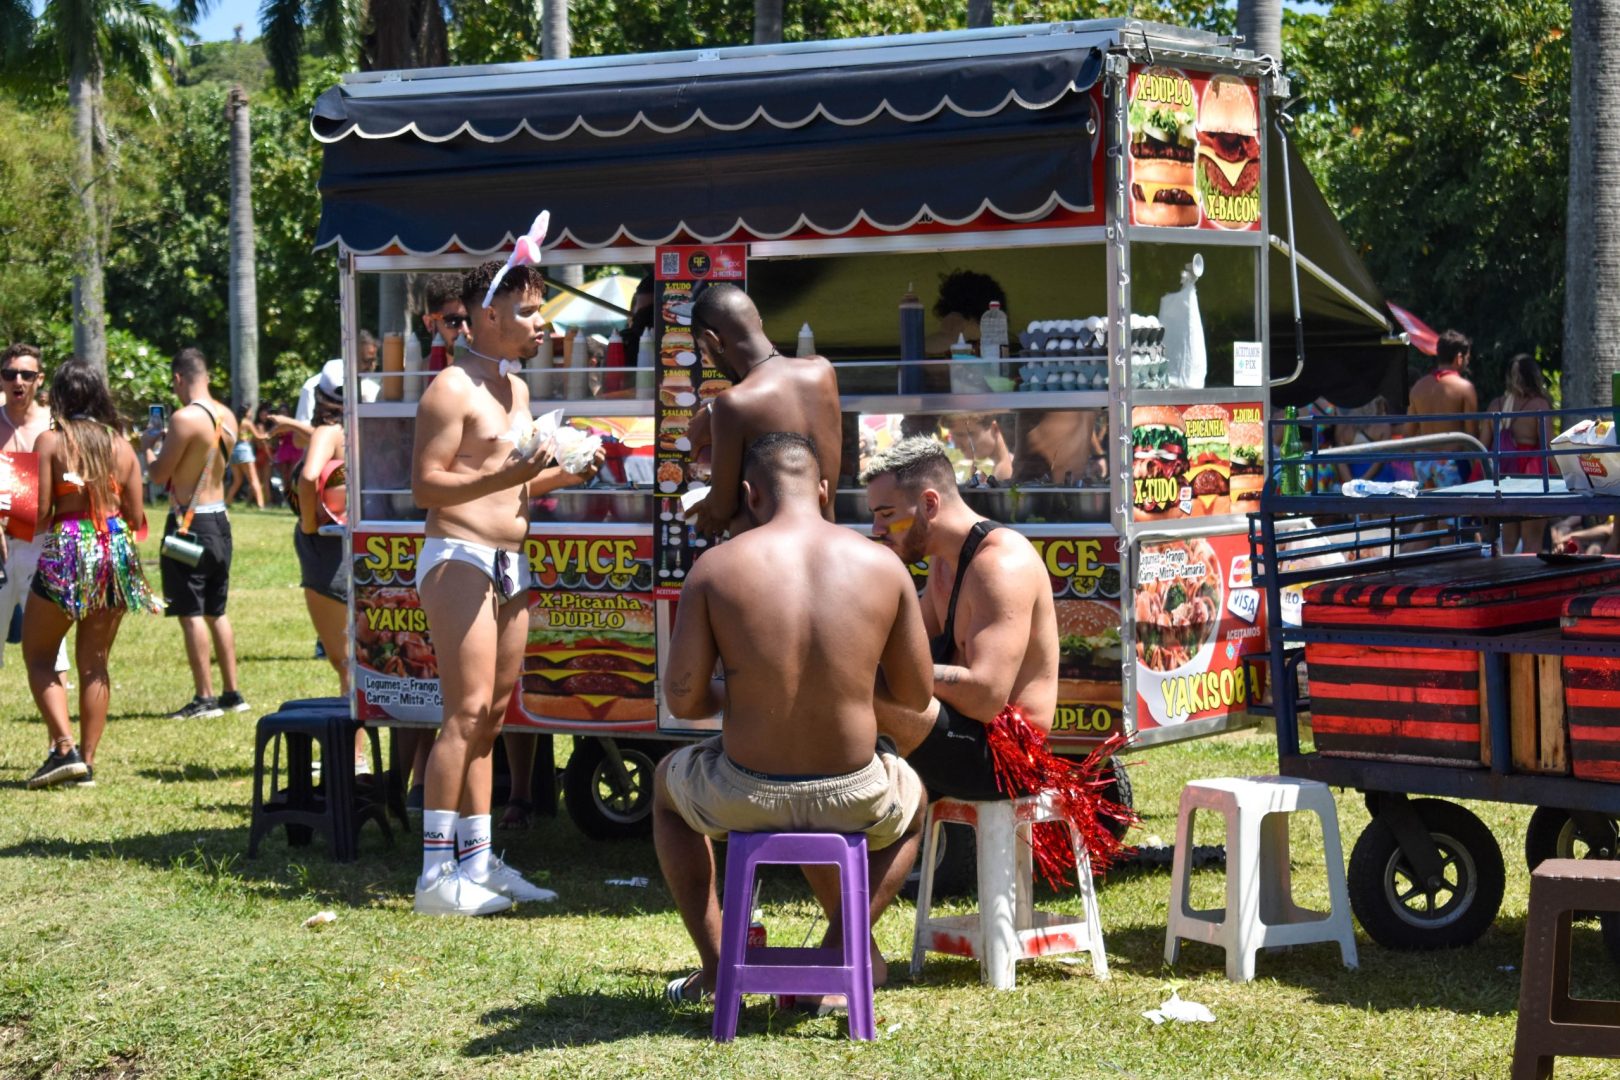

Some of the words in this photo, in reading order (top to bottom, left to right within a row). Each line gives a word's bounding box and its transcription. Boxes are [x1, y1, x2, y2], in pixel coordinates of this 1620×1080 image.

[1138, 73, 1192, 106] X-DUPLO
[1207, 194, 1258, 222] X-BACON
[665, 282, 692, 290] X-TUDO
[1233, 408, 1260, 423] X-DUPLO
[1185, 419, 1225, 438] X-PICANHA
[1134, 477, 1178, 504] X-TUDO
[524, 539, 640, 577] RVICE
[1166, 550, 1185, 562] Frango
[540, 593, 641, 610] X-Picanha
[1234, 591, 1255, 615] VISA
[365, 607, 430, 632] YAKIS
[550, 611, 624, 628] DUPLO
[366, 677, 401, 693] Legumes
[410, 682, 438, 693] Frango
[366, 693, 391, 704] Carne
[400, 693, 425, 706] Mista
